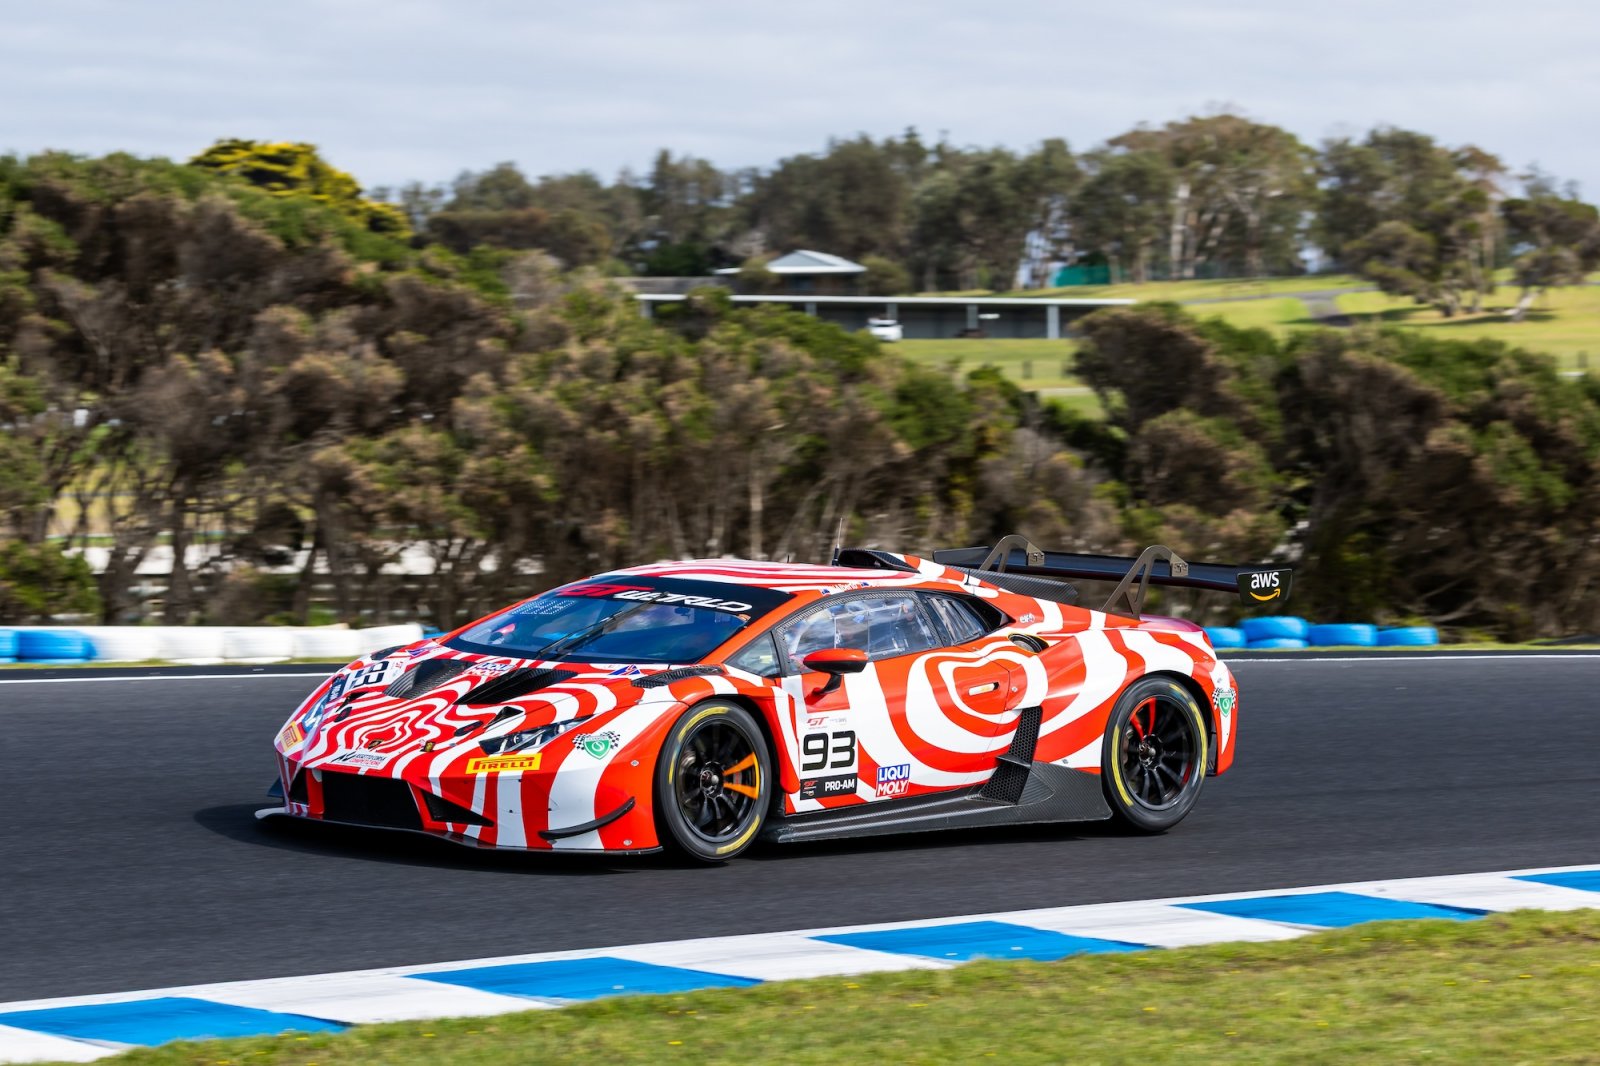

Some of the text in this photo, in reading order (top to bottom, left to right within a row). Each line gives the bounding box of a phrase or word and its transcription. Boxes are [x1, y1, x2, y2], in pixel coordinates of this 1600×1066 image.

[1251, 572, 1280, 589] aws
[802, 730, 856, 771] 93
[472, 756, 534, 771] PIRELLI
[878, 764, 910, 781] LIQUI
[825, 779, 855, 791] PRO-AM
[877, 780, 908, 797] MOLY
